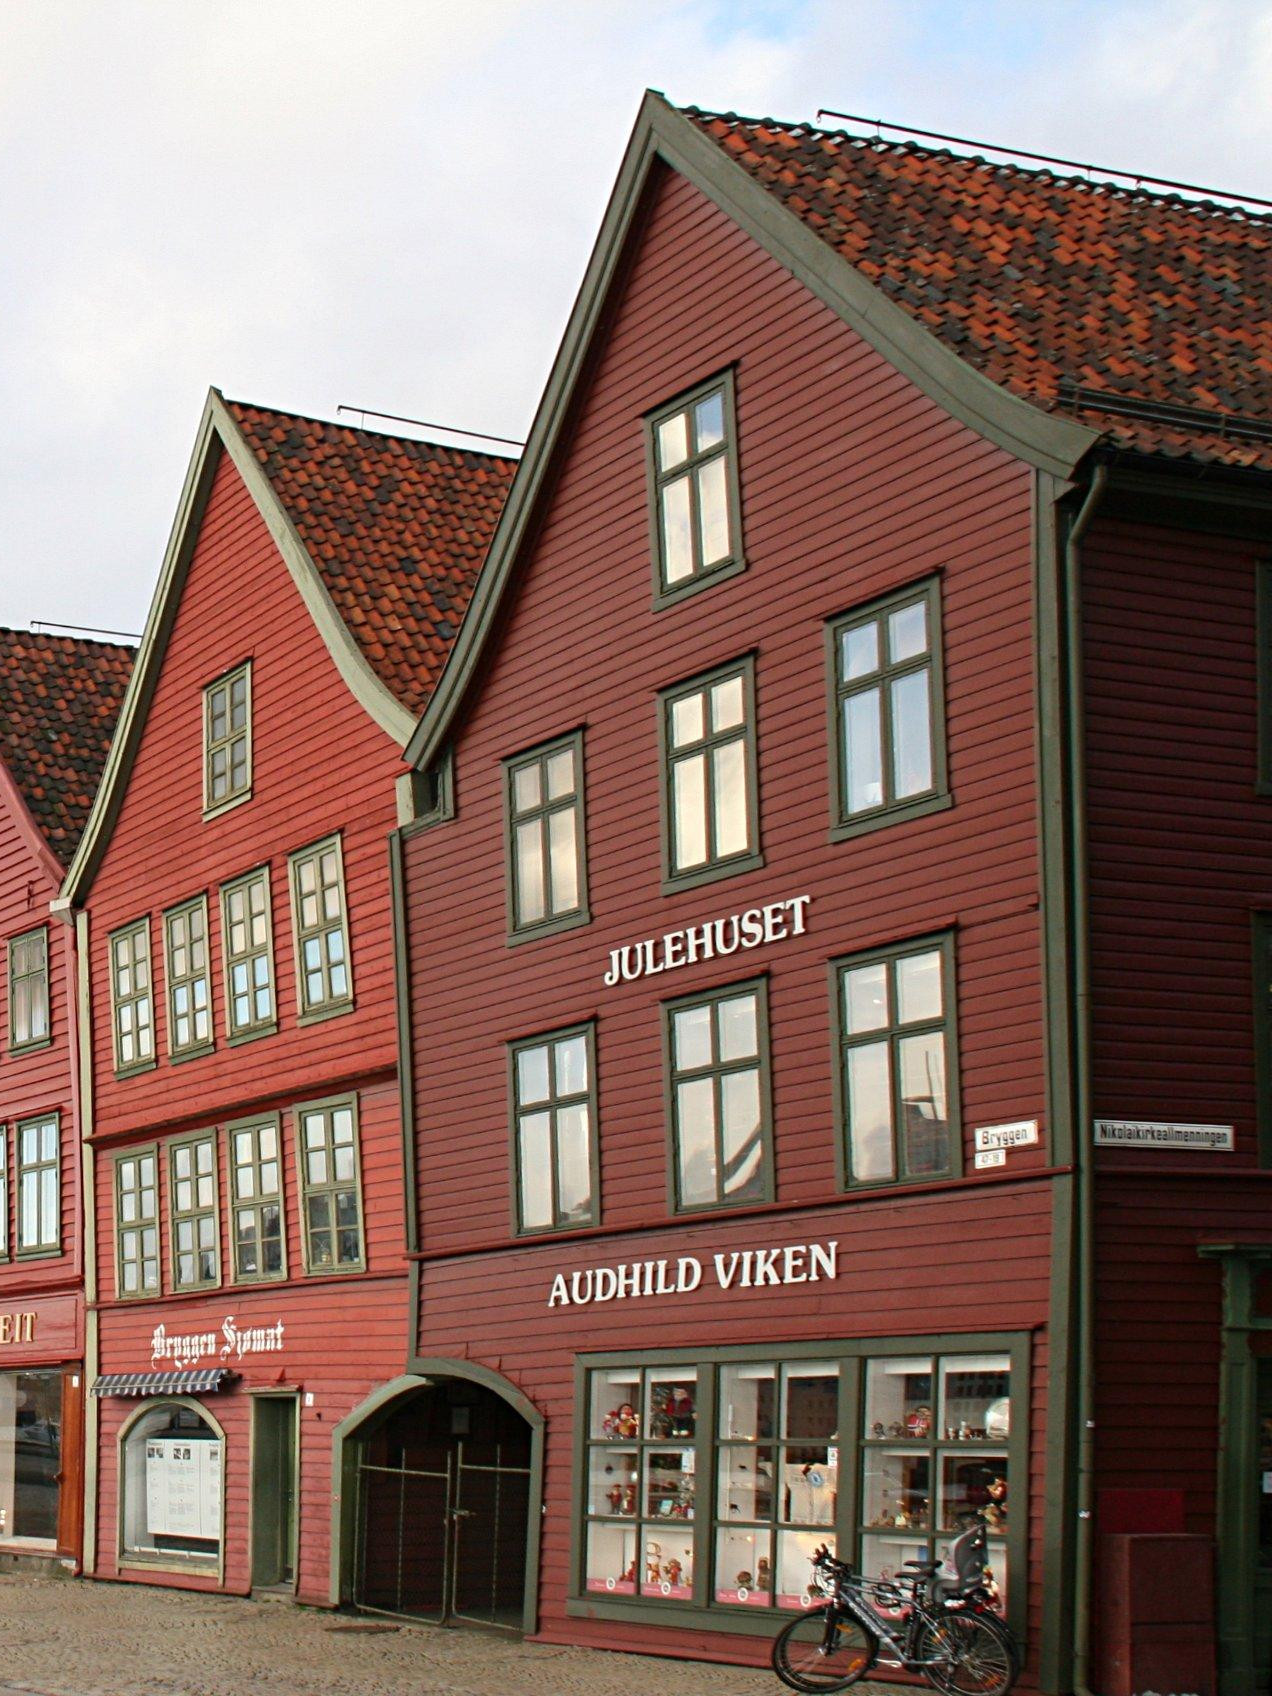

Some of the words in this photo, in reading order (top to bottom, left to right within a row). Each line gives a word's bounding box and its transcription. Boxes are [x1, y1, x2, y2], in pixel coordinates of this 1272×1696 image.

[604, 895, 811, 985] JULEHUSET
[981, 1128, 1028, 1147] Bryggen
[1100, 1123, 1228, 1147] Nikolaikirkeallmenningen
[548, 1257, 703, 1307] AUDHILD
[713, 1242, 839, 1289] VIKEN
[151, 1323, 216, 1370] Bryggen
